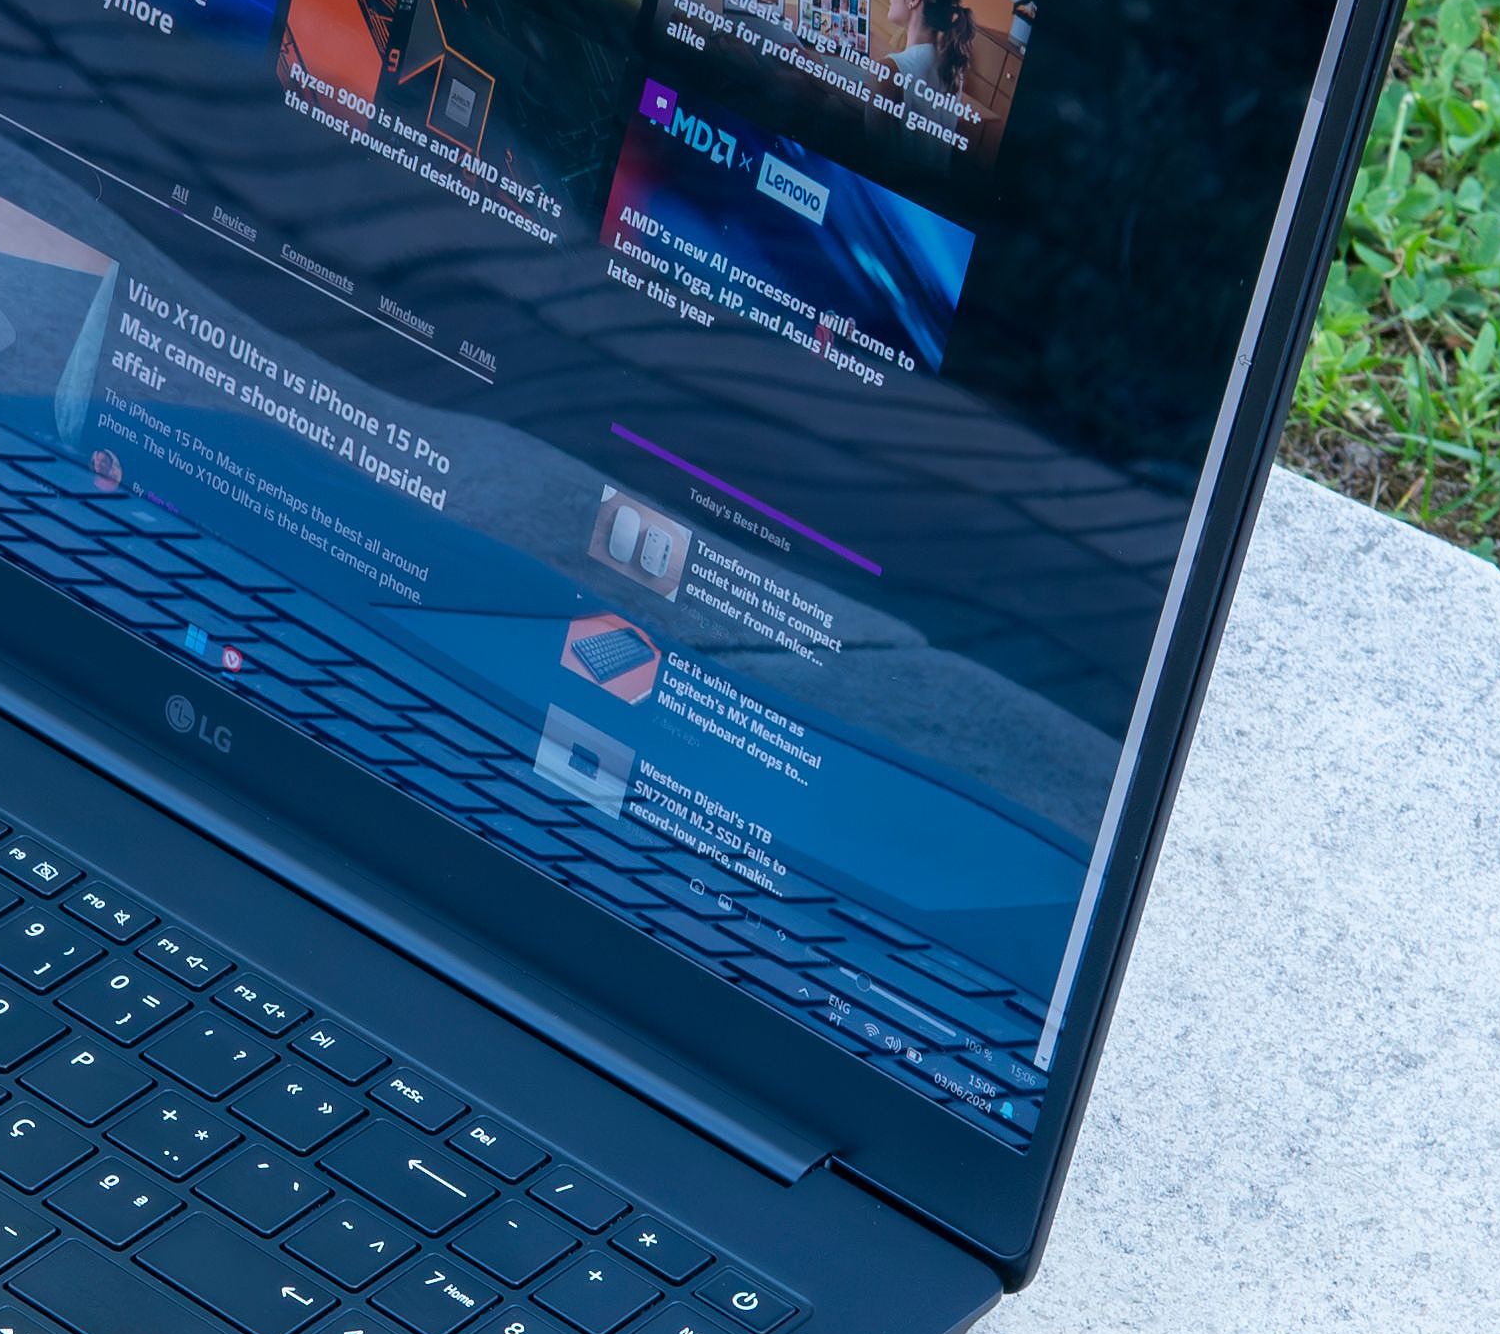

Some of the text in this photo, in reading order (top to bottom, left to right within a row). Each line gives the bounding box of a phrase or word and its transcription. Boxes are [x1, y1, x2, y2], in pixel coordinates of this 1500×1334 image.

[665, 21, 706, 51] alike
[735, 20, 761, 46] for
[760, 38, 871, 103] professionals
[872, 93, 906, 120] and
[904, 110, 969, 151] gamers
[782, 16, 794, 33] a
[797, 22, 838, 56] huge
[839, 40, 890, 82] lineup
[892, 72, 913, 90] of
[913, 78, 982, 125] Copilot+
[289, 61, 562, 218] Ryzen 9000 is here and AMD says it's
[284, 89, 558, 244] the most powerful desktop processor
[765, 162, 822, 211] Lenovo
[171, 183, 190, 204] All
[211, 204, 258, 239] Devices
[279, 243, 355, 296] Components
[606, 258, 715, 327] later this year
[619, 205, 915, 372] AMD's new AI processors will come to
[379, 294, 436, 336] Windows
[613, 231, 885, 387] Lenovo Yoga, HP, and Asus laptops
[111, 349, 167, 391] affair
[128, 277, 450, 474] Vivo X100 Ultra vs iPhone 15 Pro
[458, 339, 497, 370] AI/ML
[119, 312, 447, 511] Max camera shootout: A lopsided
[689, 487, 791, 552] Today's Best Deals
[690, 563, 842, 654] outlet with this compact
[697, 539, 834, 629] Transform that boring
[685, 582, 742, 620] extender
[742, 611, 774, 639] from
[774, 630, 823, 667] Anker...
[199, 715, 232, 753] LG
[828, 993, 852, 1015] ENG
[828, 1011, 843, 1026] PT
[391, 1080, 423, 1103] PrtSc
[933, 1072, 992, 1113] 03/06/2024
[968, 1073, 997, 1097] 15:06
[471, 1128, 496, 1146] Del
